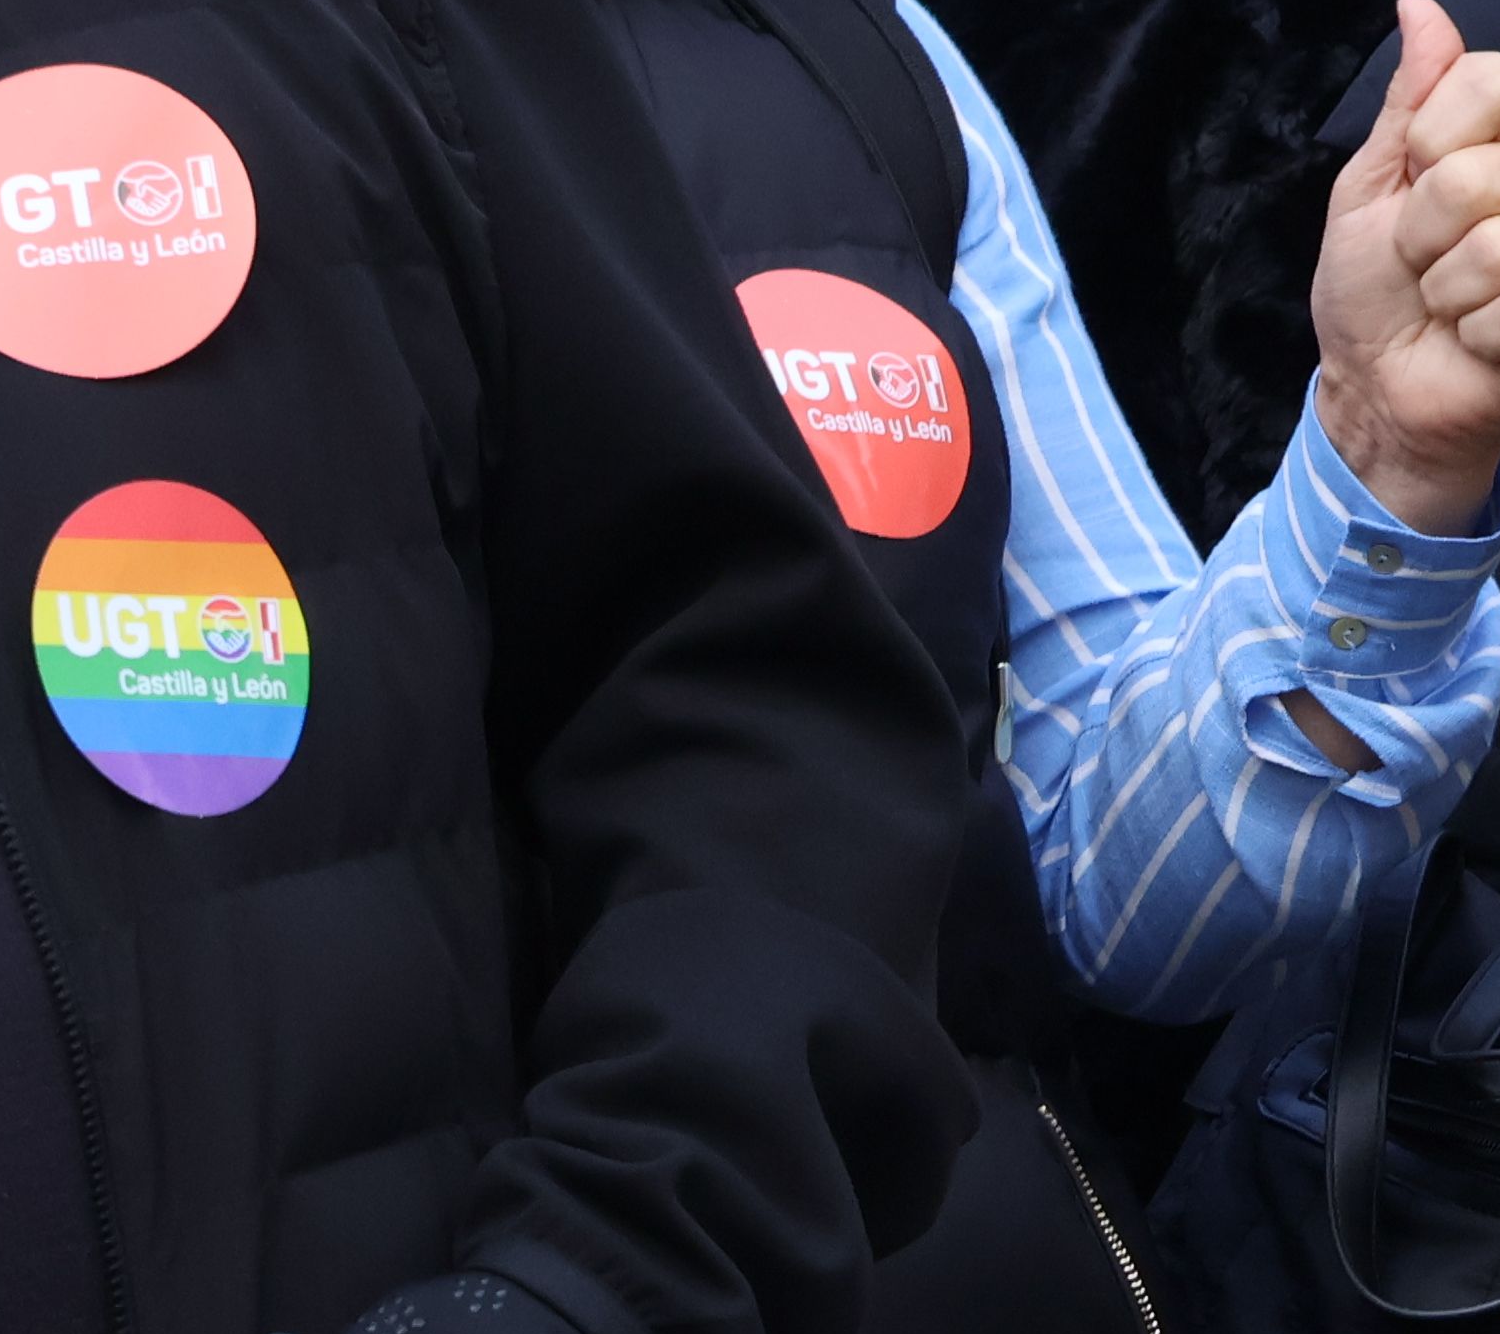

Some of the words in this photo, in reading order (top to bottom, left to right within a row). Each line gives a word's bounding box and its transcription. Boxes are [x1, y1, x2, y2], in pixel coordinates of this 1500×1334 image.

[16, 236, 125, 268] Castilla
[131, 241, 149, 267] y
[155, 228, 227, 259] León
[806, 407, 886, 435] Castilla
[889, 419, 903, 443] y
[906, 414, 953, 444] León
[56, 593, 187, 660] UGT
[118, 668, 206, 697] Castilla
[212, 679, 229, 705] y
[233, 672, 287, 701] León
